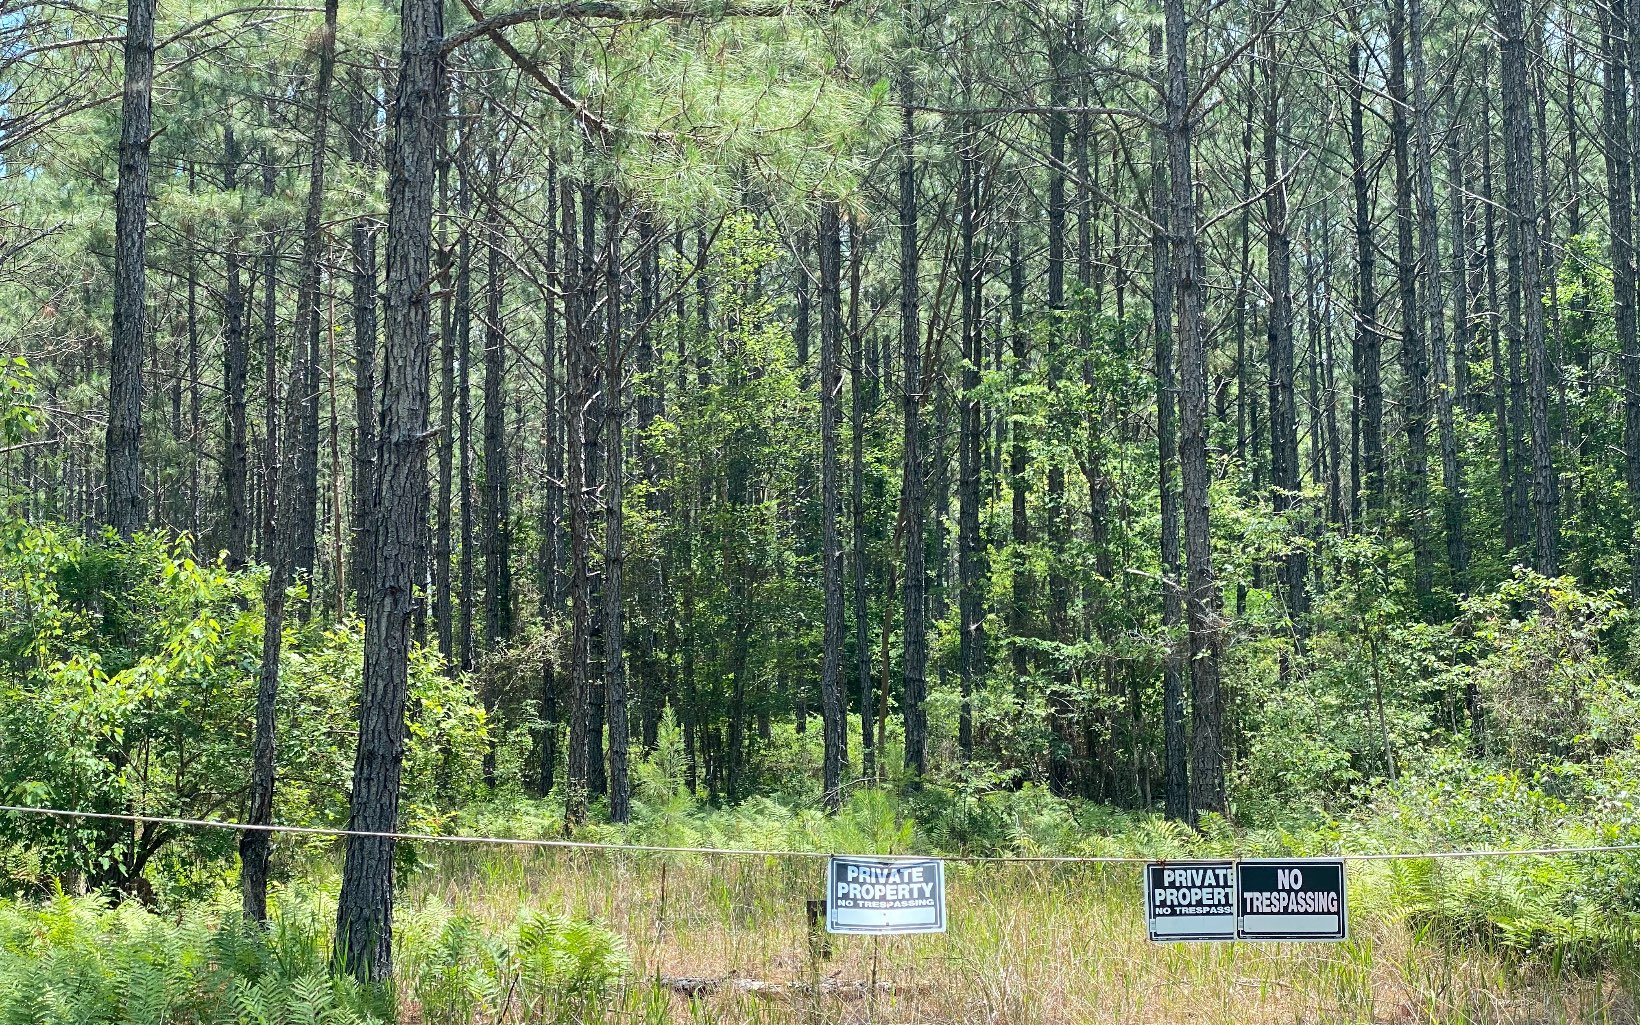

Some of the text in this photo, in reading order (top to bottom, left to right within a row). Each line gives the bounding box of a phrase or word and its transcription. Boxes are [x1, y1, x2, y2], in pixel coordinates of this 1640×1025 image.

[847, 865, 923, 883] PRIVATE
[1277, 868, 1303, 890] NO
[837, 882, 933, 900] PROPERTY
[857, 899, 935, 908] TRESPASSING
[1155, 907, 1171, 915] NO
[1243, 891, 1338, 913] TRESPASSING
